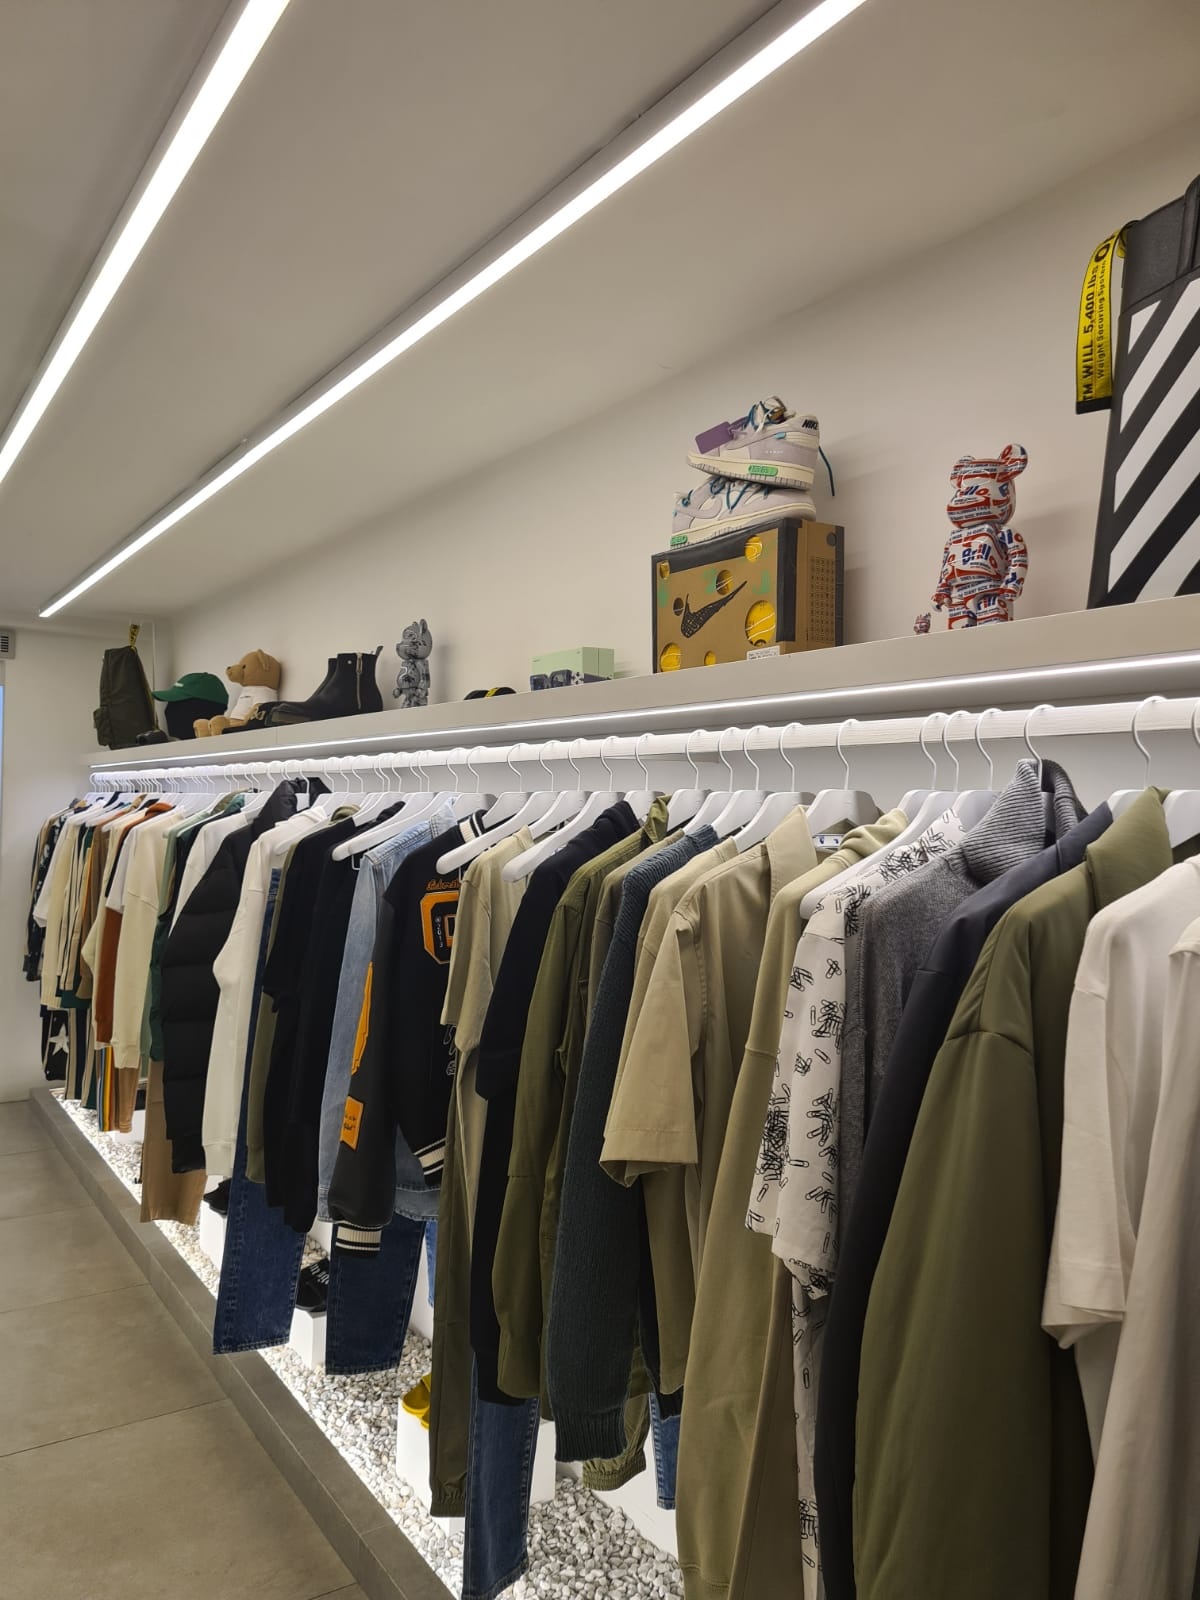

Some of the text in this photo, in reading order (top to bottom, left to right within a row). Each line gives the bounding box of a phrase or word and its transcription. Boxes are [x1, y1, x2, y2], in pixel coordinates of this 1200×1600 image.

[1087, 264, 1099, 289] lbs
[1083, 292, 1096, 334] 5,400
[1082, 340, 1094, 379] WILL
